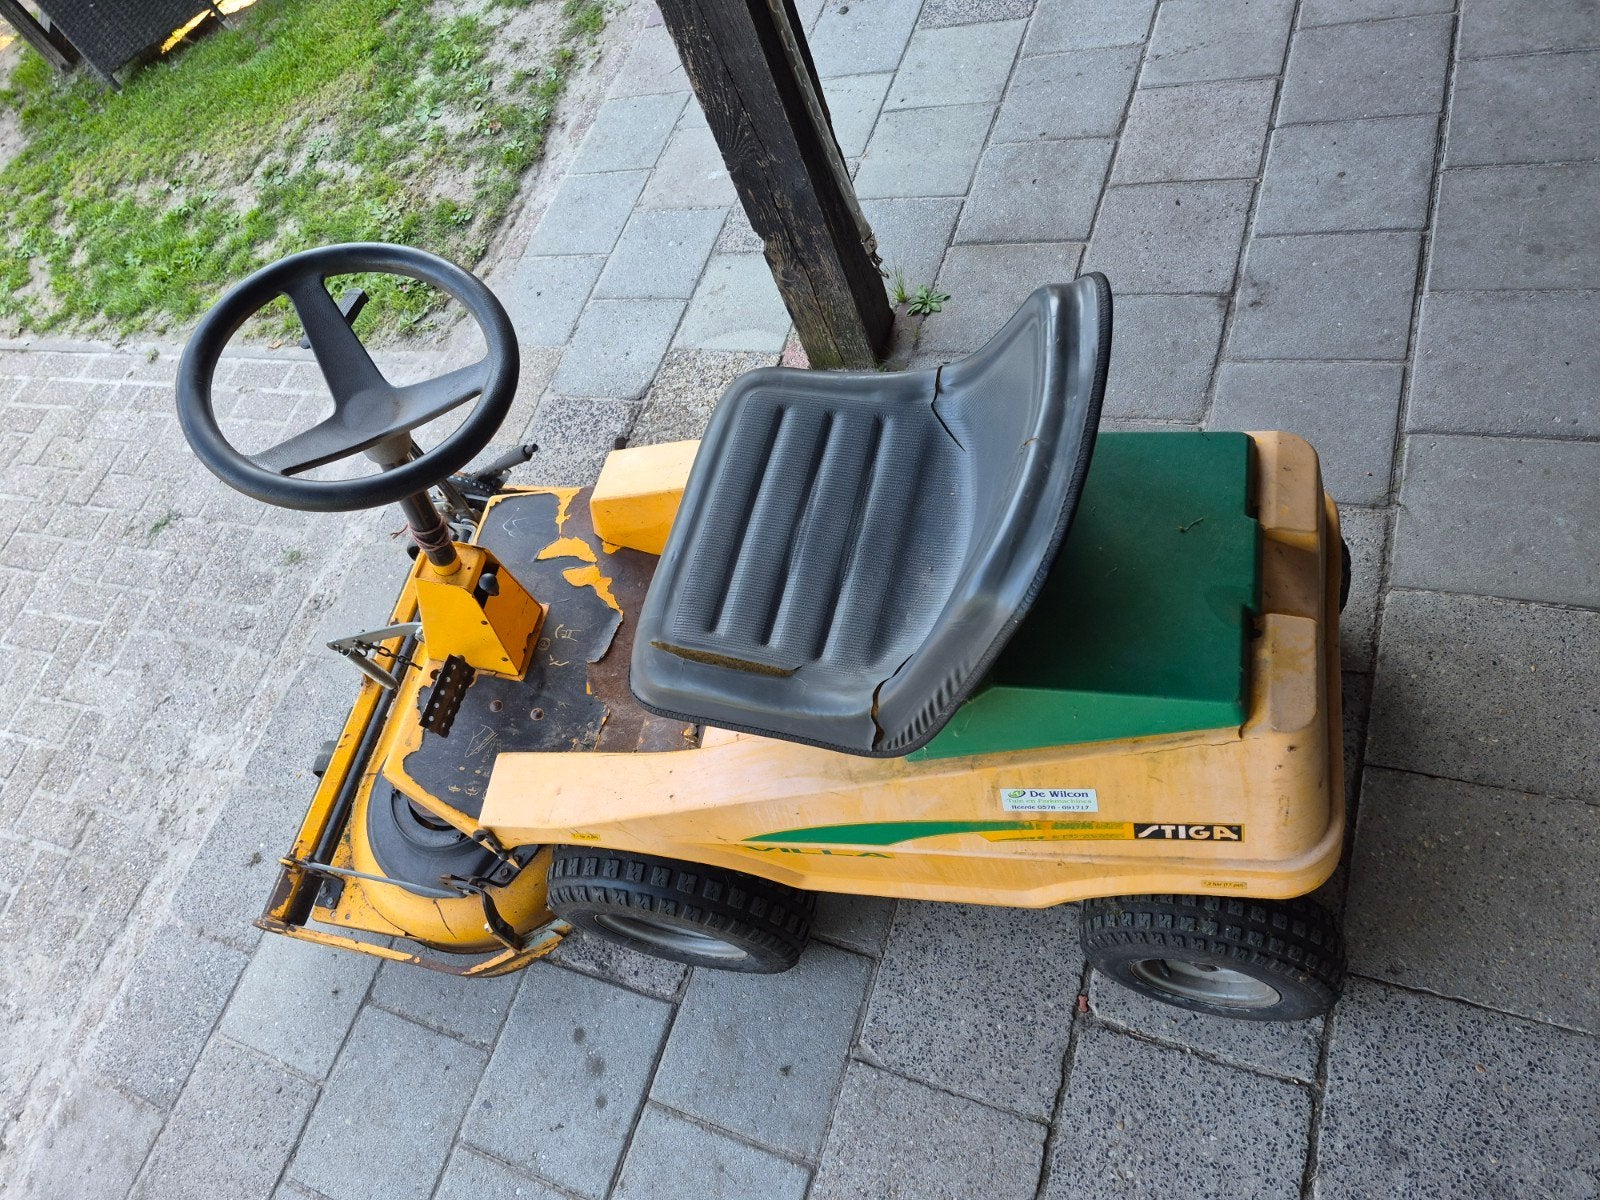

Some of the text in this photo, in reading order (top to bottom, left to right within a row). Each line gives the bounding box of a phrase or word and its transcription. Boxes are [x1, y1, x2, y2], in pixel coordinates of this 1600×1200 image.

[1029, 790, 1089, 798] De Wilcon
[1137, 824, 1239, 841] STIGA
[742, 845, 894, 860] VILLA
